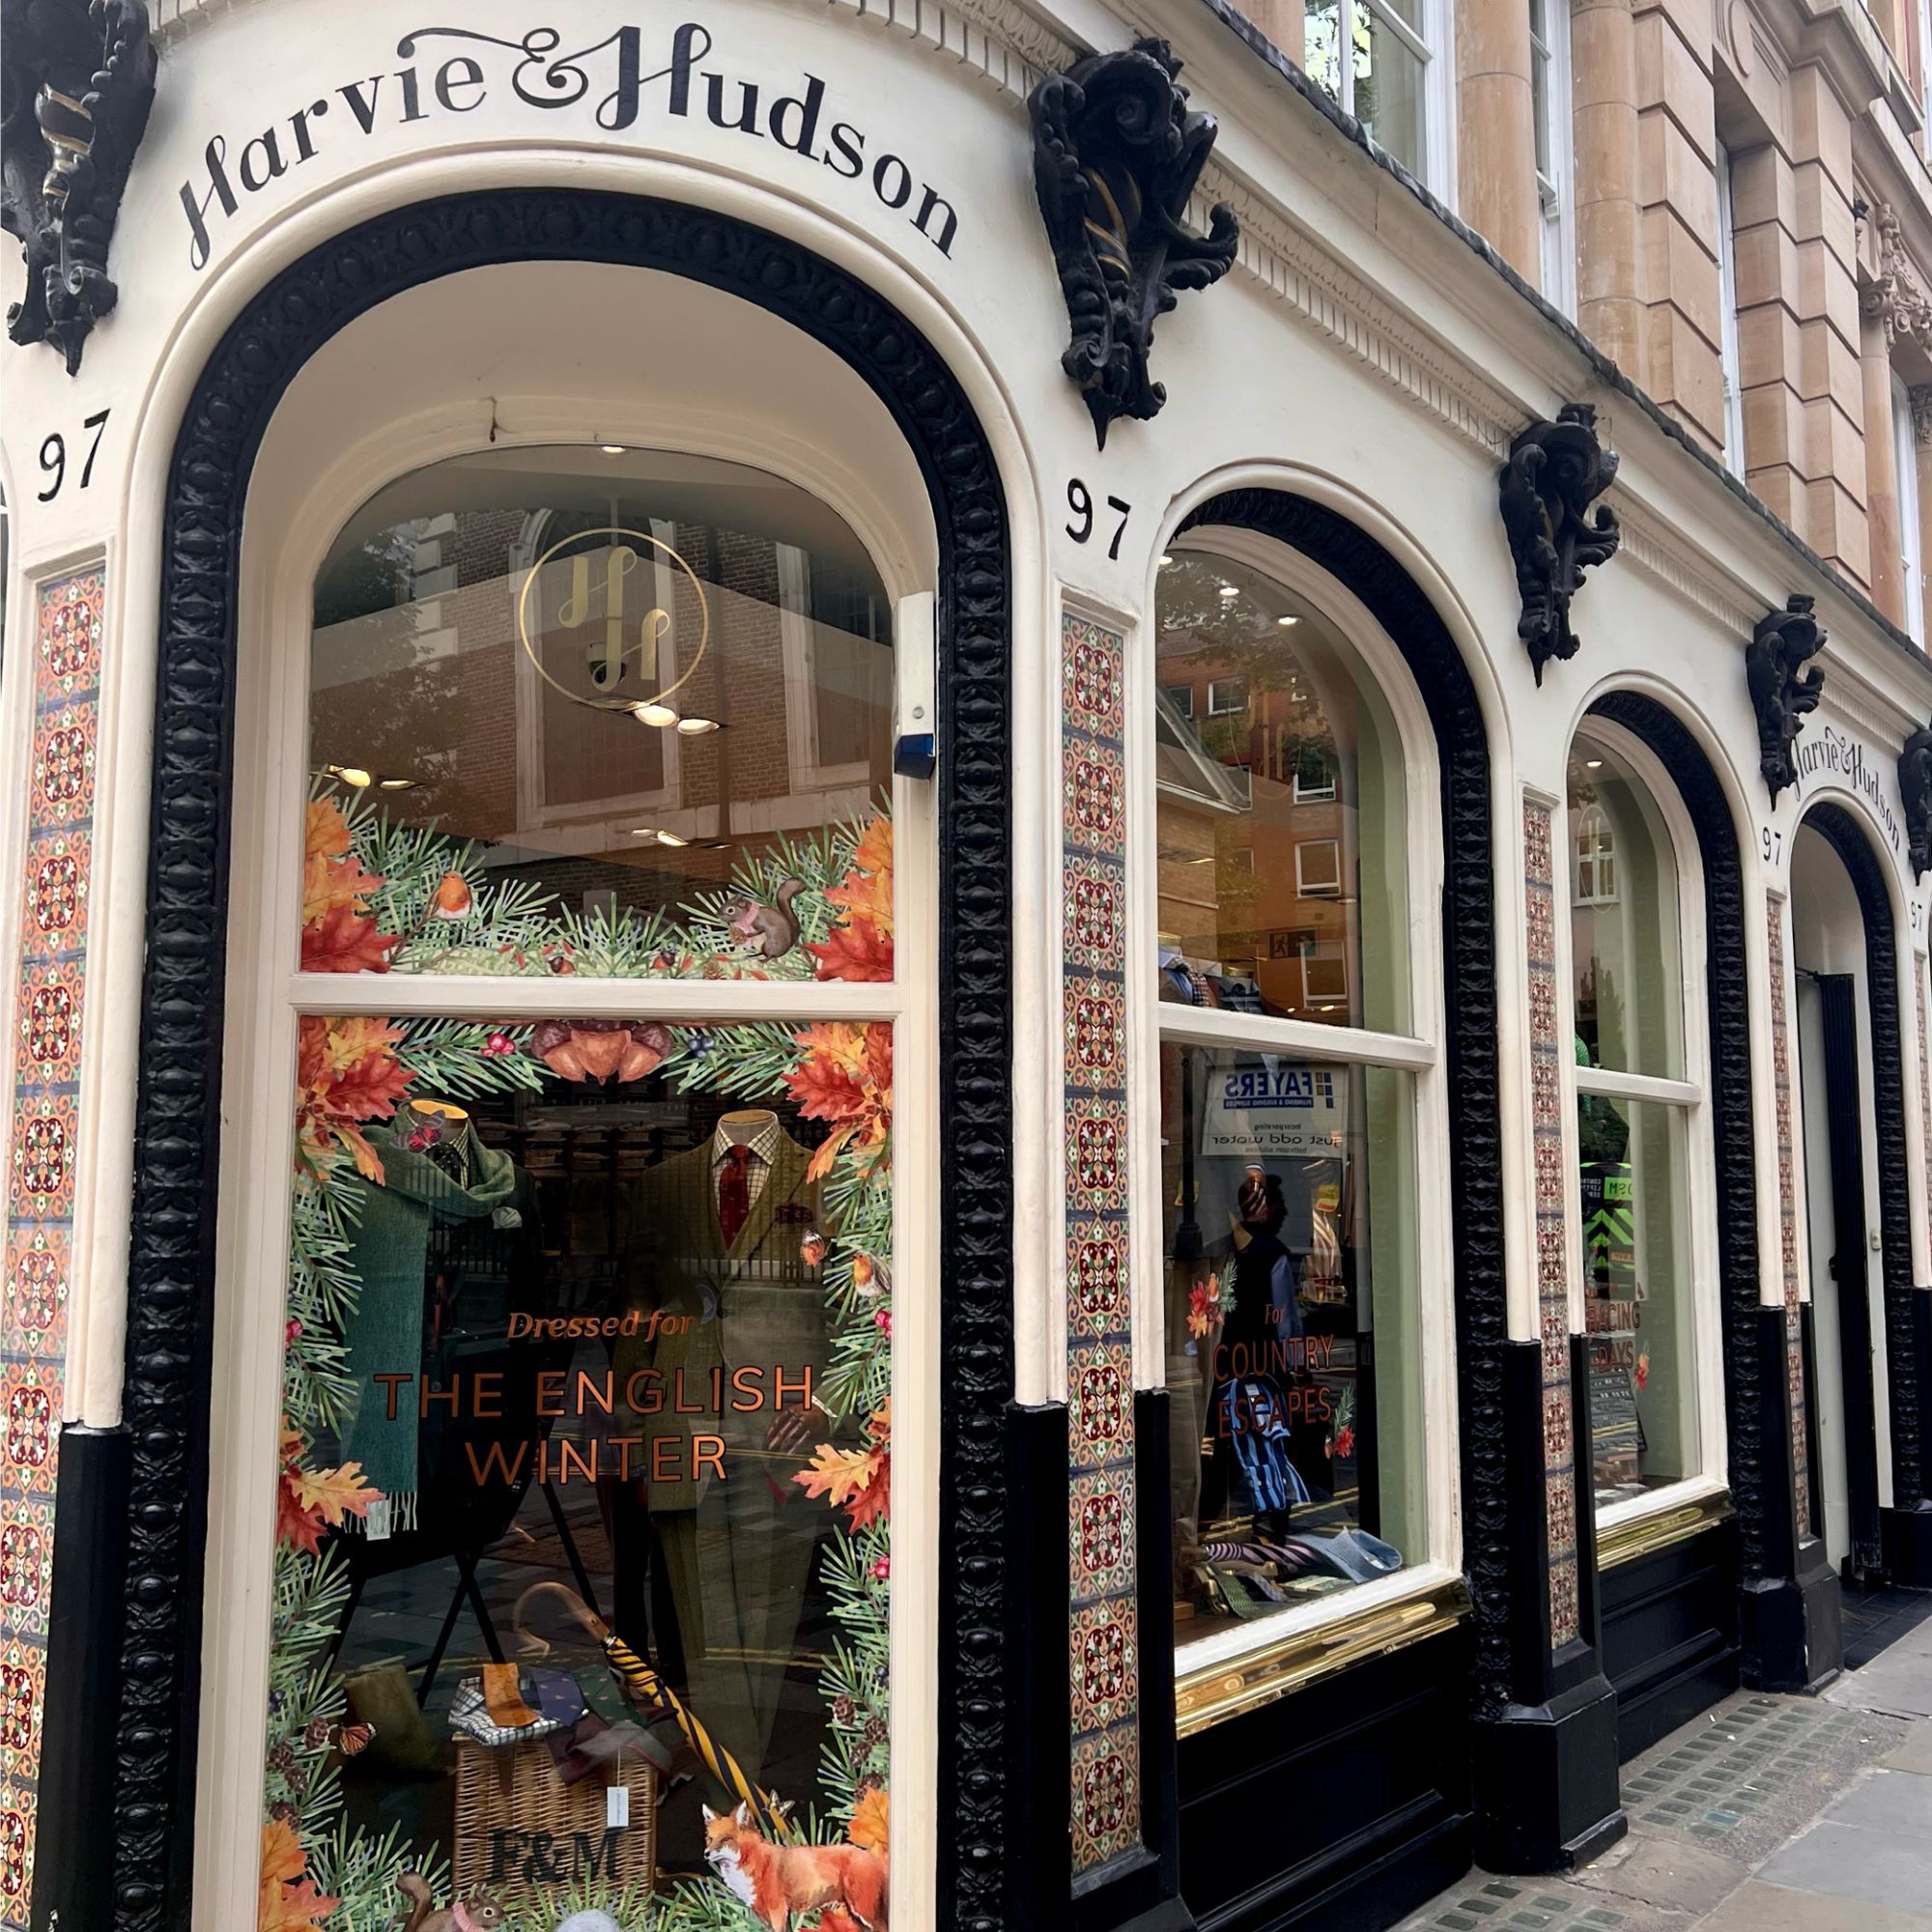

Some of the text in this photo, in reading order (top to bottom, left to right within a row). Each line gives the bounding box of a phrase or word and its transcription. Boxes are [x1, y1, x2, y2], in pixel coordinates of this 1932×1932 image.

[178, 50, 487, 271] Harvie
[595, 22, 959, 261] Hudson
[37, 408, 111, 502] 97
[1064, 477, 1131, 561] 97
[1852, 743, 1901, 855] Hudson
[1762, 826, 1781, 867] 97
[506, 1310, 696, 1343] Dressed for
[1264, 1303, 1285, 1325] For
[1586, 1301, 1641, 1334] RACING
[1213, 1333, 1335, 1382] COUNTRY
[1597, 1340, 1634, 1372] DAYS
[373, 1364, 813, 1422] THE ENGLISH
[1218, 1386, 1332, 1439] ESCAPES
[465, 1435, 727, 1487] WINTER
[488, 1826, 623, 1884] F&M
